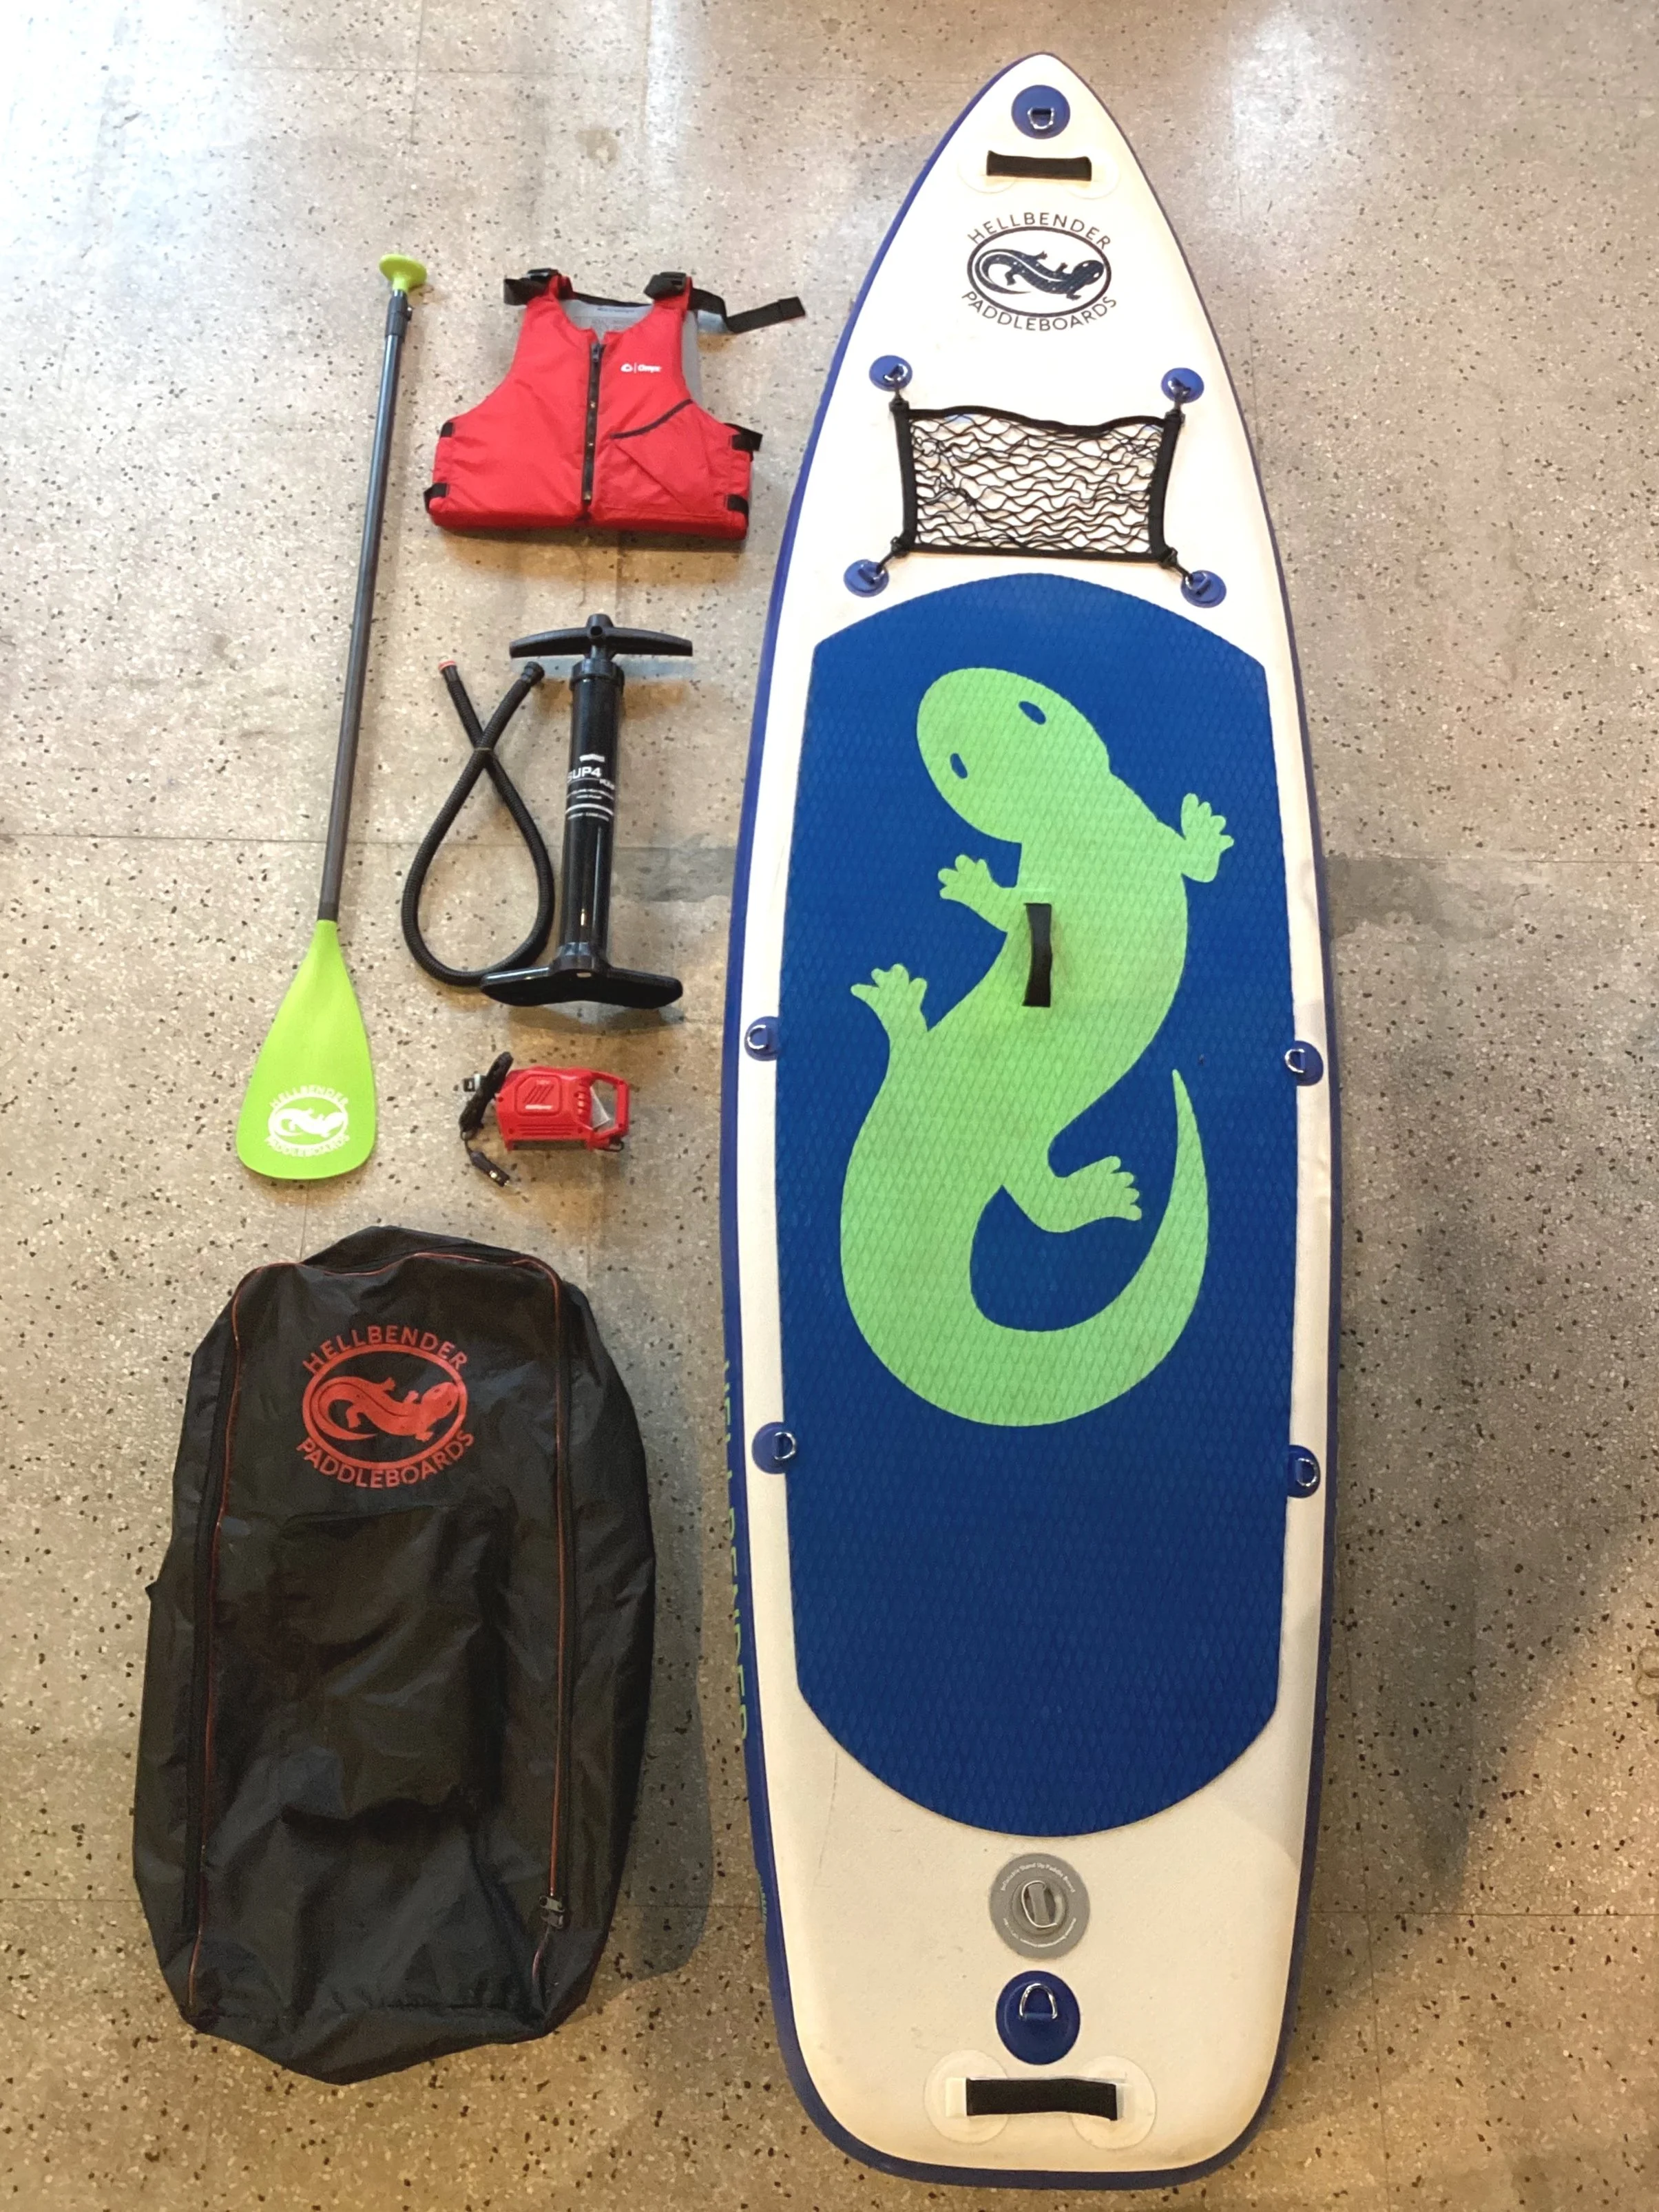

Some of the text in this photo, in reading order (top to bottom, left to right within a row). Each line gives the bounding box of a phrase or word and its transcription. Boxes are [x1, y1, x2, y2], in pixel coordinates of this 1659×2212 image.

[967, 211, 1111, 250] HELLBENDER
[961, 291, 1117, 331] PADDLEBOARDS
[269, 1084, 348, 1109] HELLBENDER
[302, 1324, 468, 1375] HELLBENDER
[296, 1429, 474, 1488] PADDLEBOARDS
